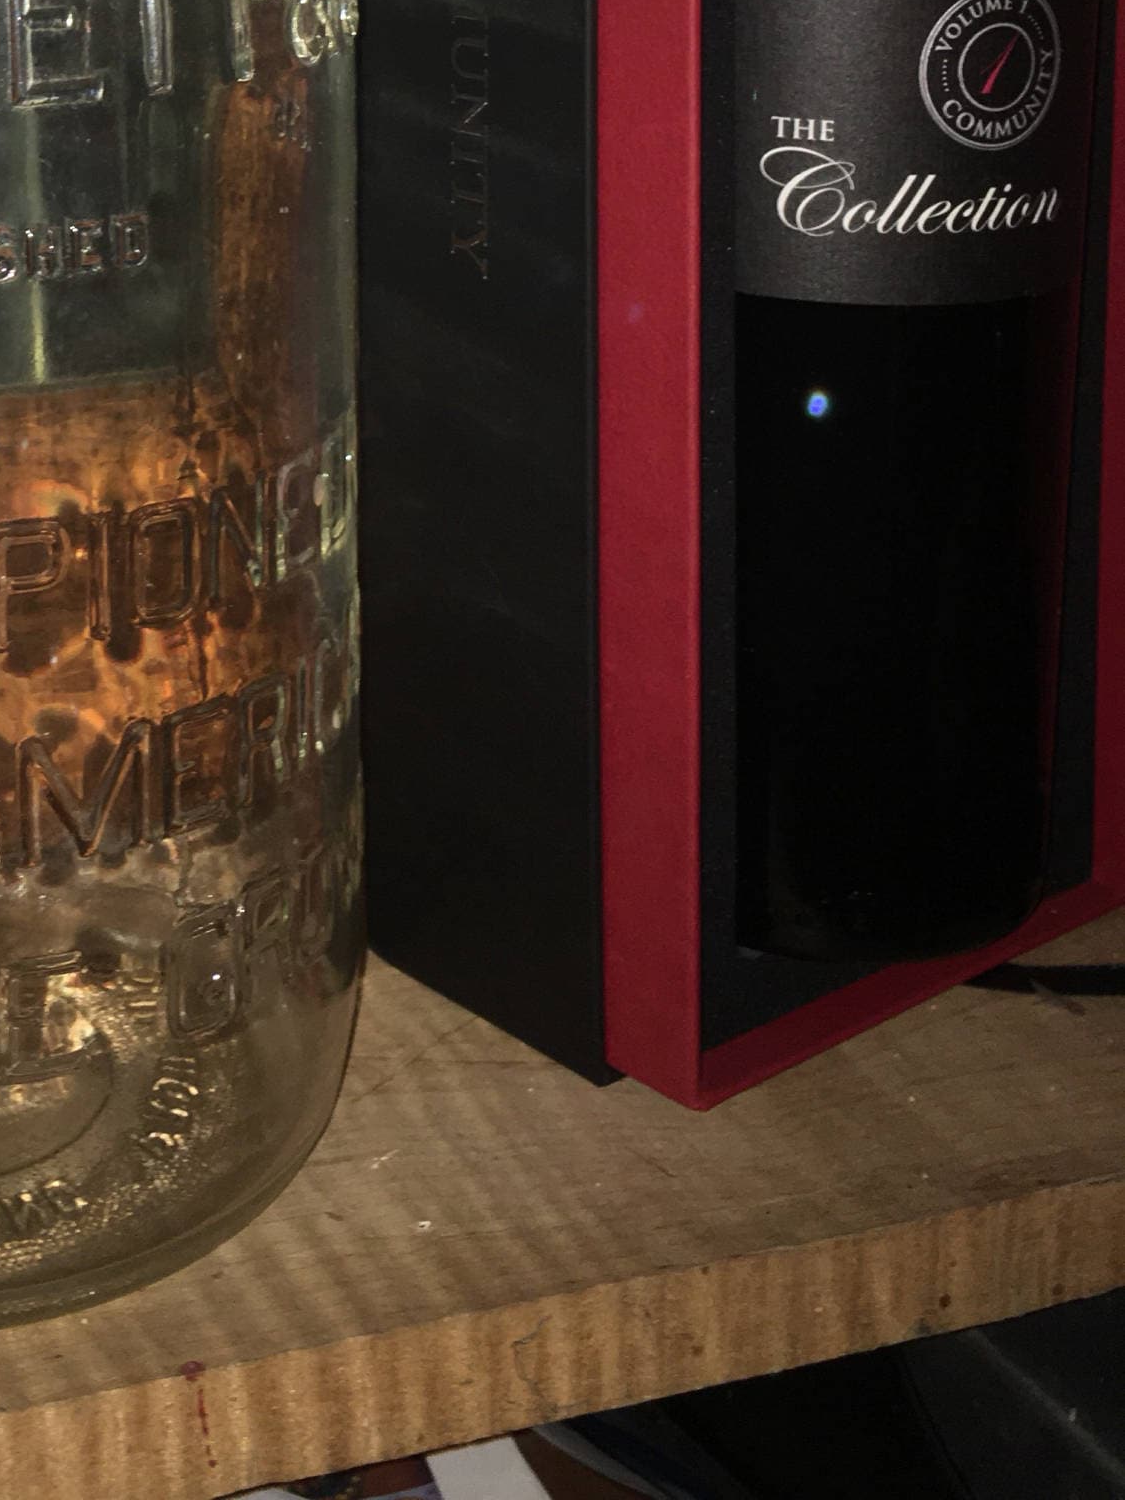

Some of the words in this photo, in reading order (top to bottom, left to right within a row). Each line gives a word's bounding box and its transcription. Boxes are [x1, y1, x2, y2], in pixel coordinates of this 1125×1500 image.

[771, 115, 835, 142] THE
[941, 48, 1055, 140] COMMUNITY
[759, 146, 1059, 237] Collection
